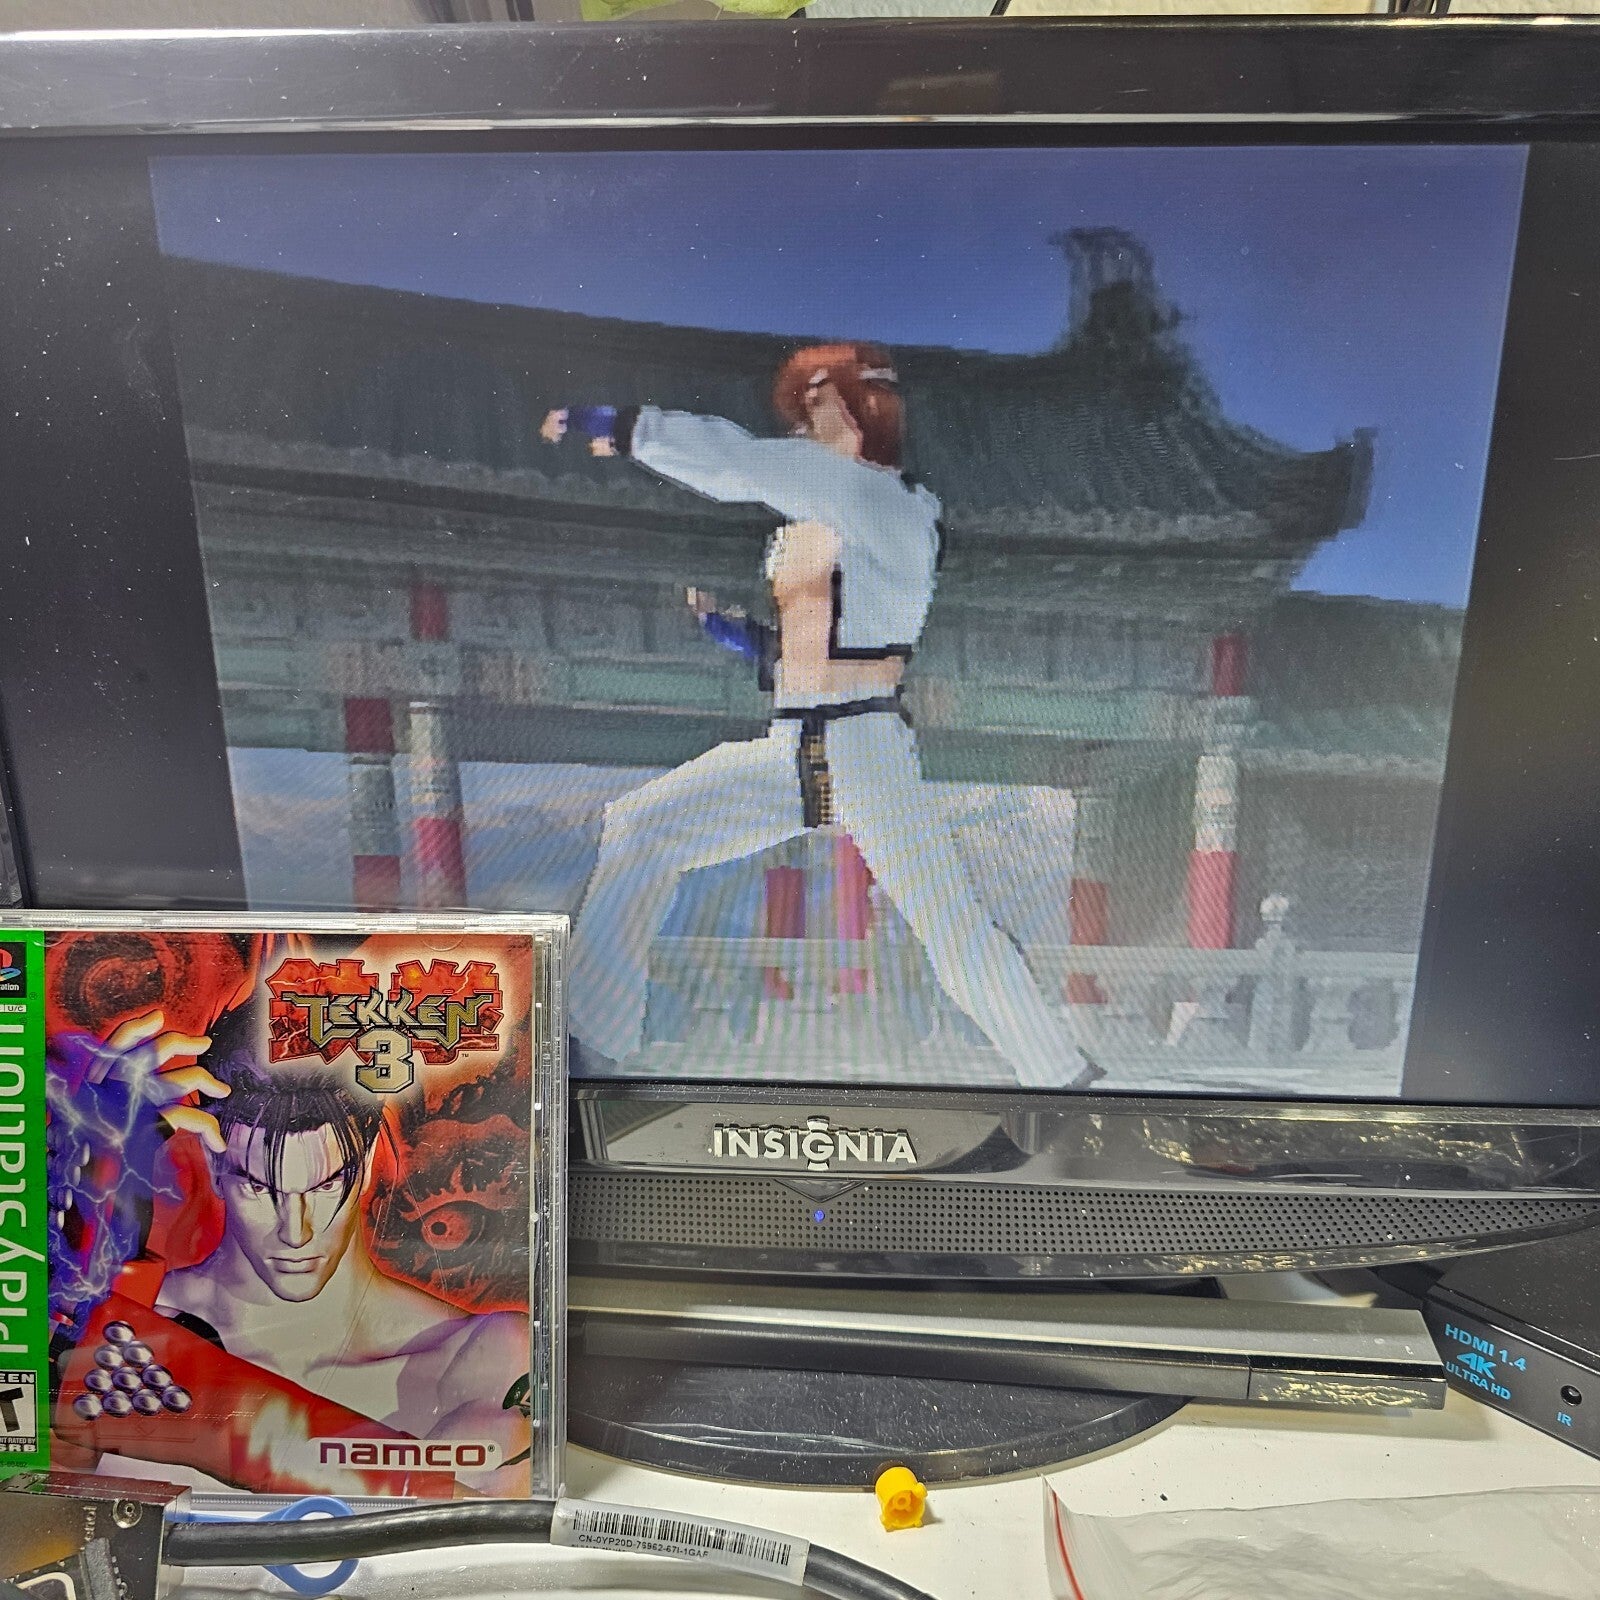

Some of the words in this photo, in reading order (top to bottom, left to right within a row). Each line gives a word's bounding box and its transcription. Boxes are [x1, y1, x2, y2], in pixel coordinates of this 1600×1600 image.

[281, 988, 494, 1049] TEKKEN
[356, 1025, 414, 1094] 3
[713, 1119, 918, 1169] INSIGNIA
[1444, 1323, 1495, 1357] HDMI
[1499, 1349, 1528, 1372] 1.4
[1456, 1352, 1497, 1380] 4K
[1445, 1361, 1490, 1391] ULTRA
[1490, 1382, 1512, 1400] HD
[1556, 1411, 1573, 1427] IR
